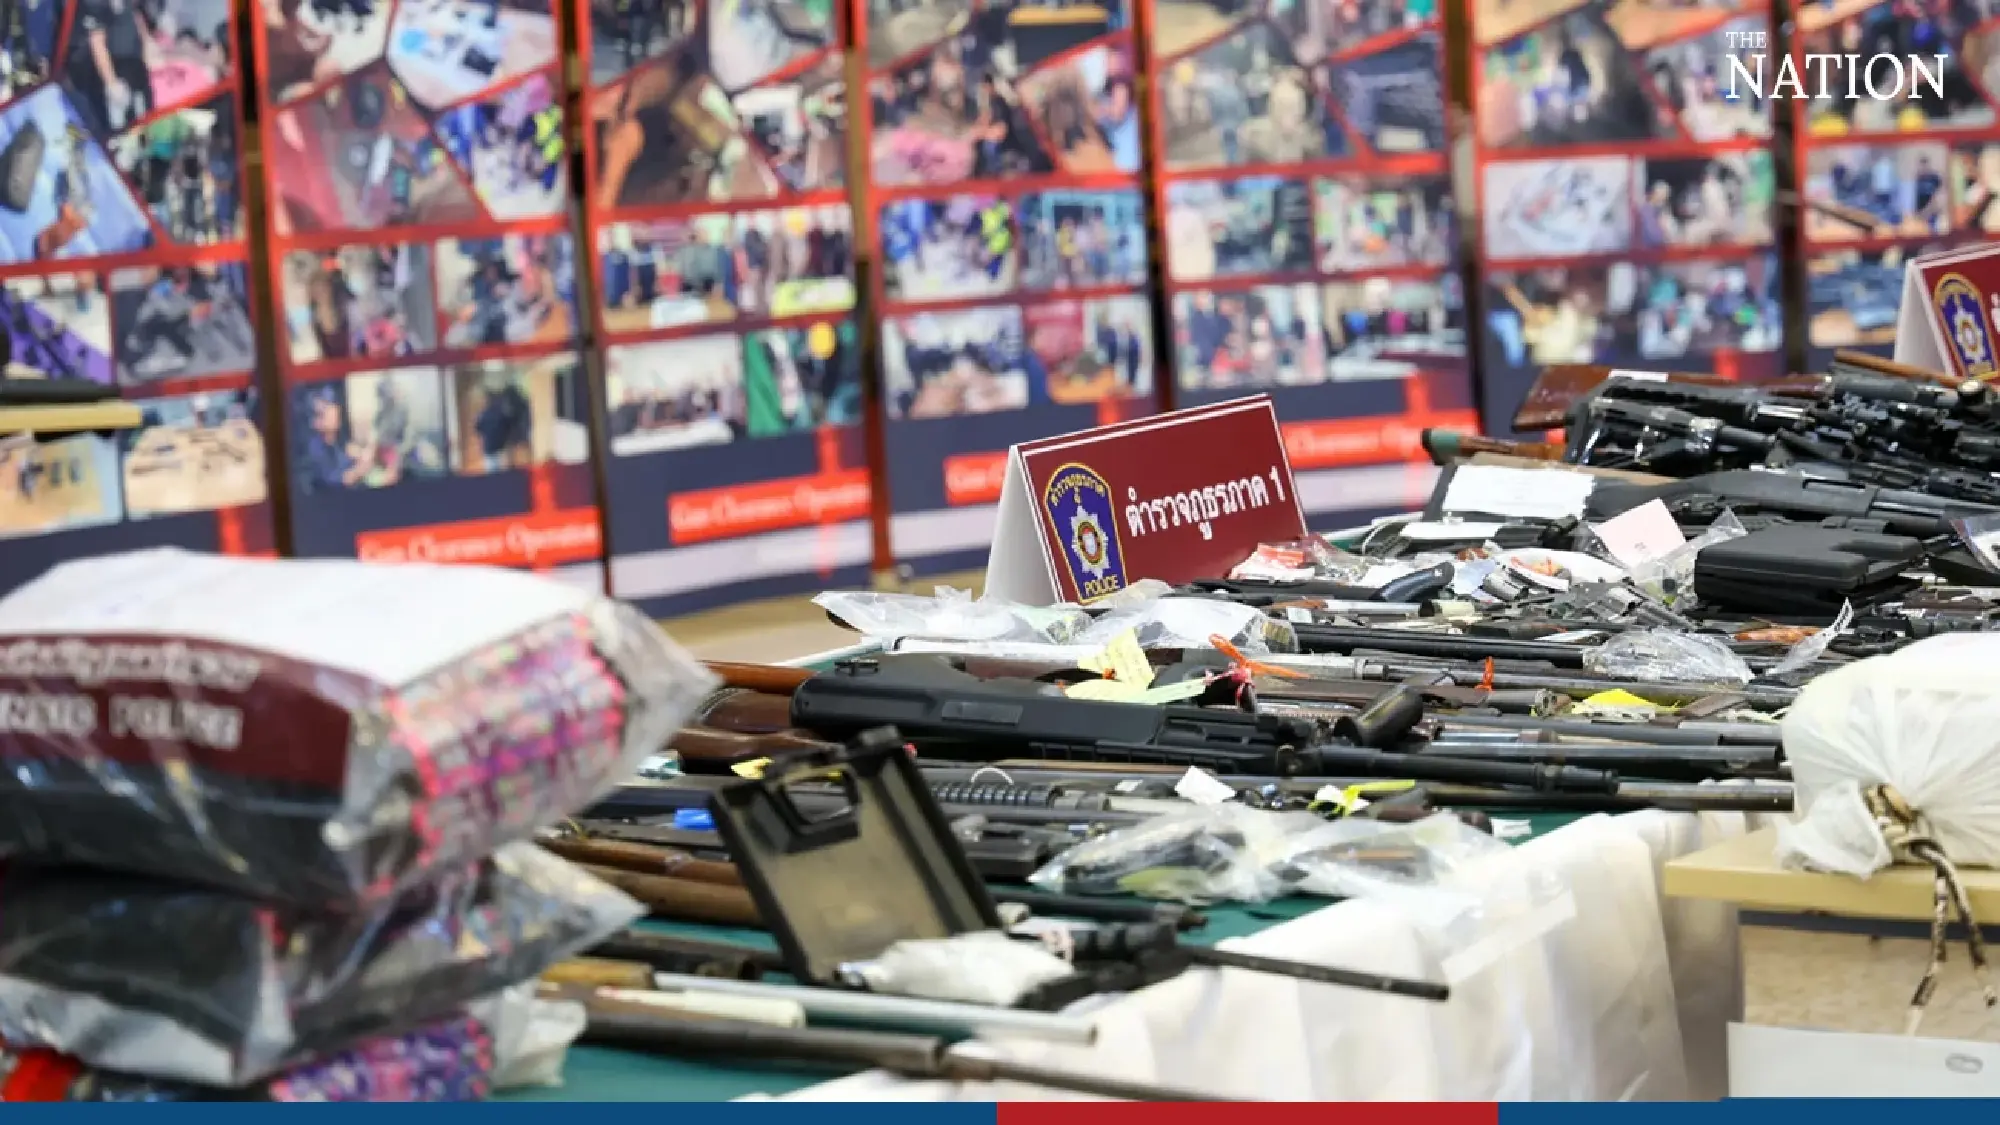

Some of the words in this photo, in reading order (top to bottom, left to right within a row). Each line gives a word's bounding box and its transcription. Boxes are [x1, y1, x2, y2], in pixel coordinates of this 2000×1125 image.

[1126, 475, 1269, 540] ตำรวจภูธรภาค
[1269, 465, 1286, 502] 1
[1085, 575, 1120, 597] POLICE
